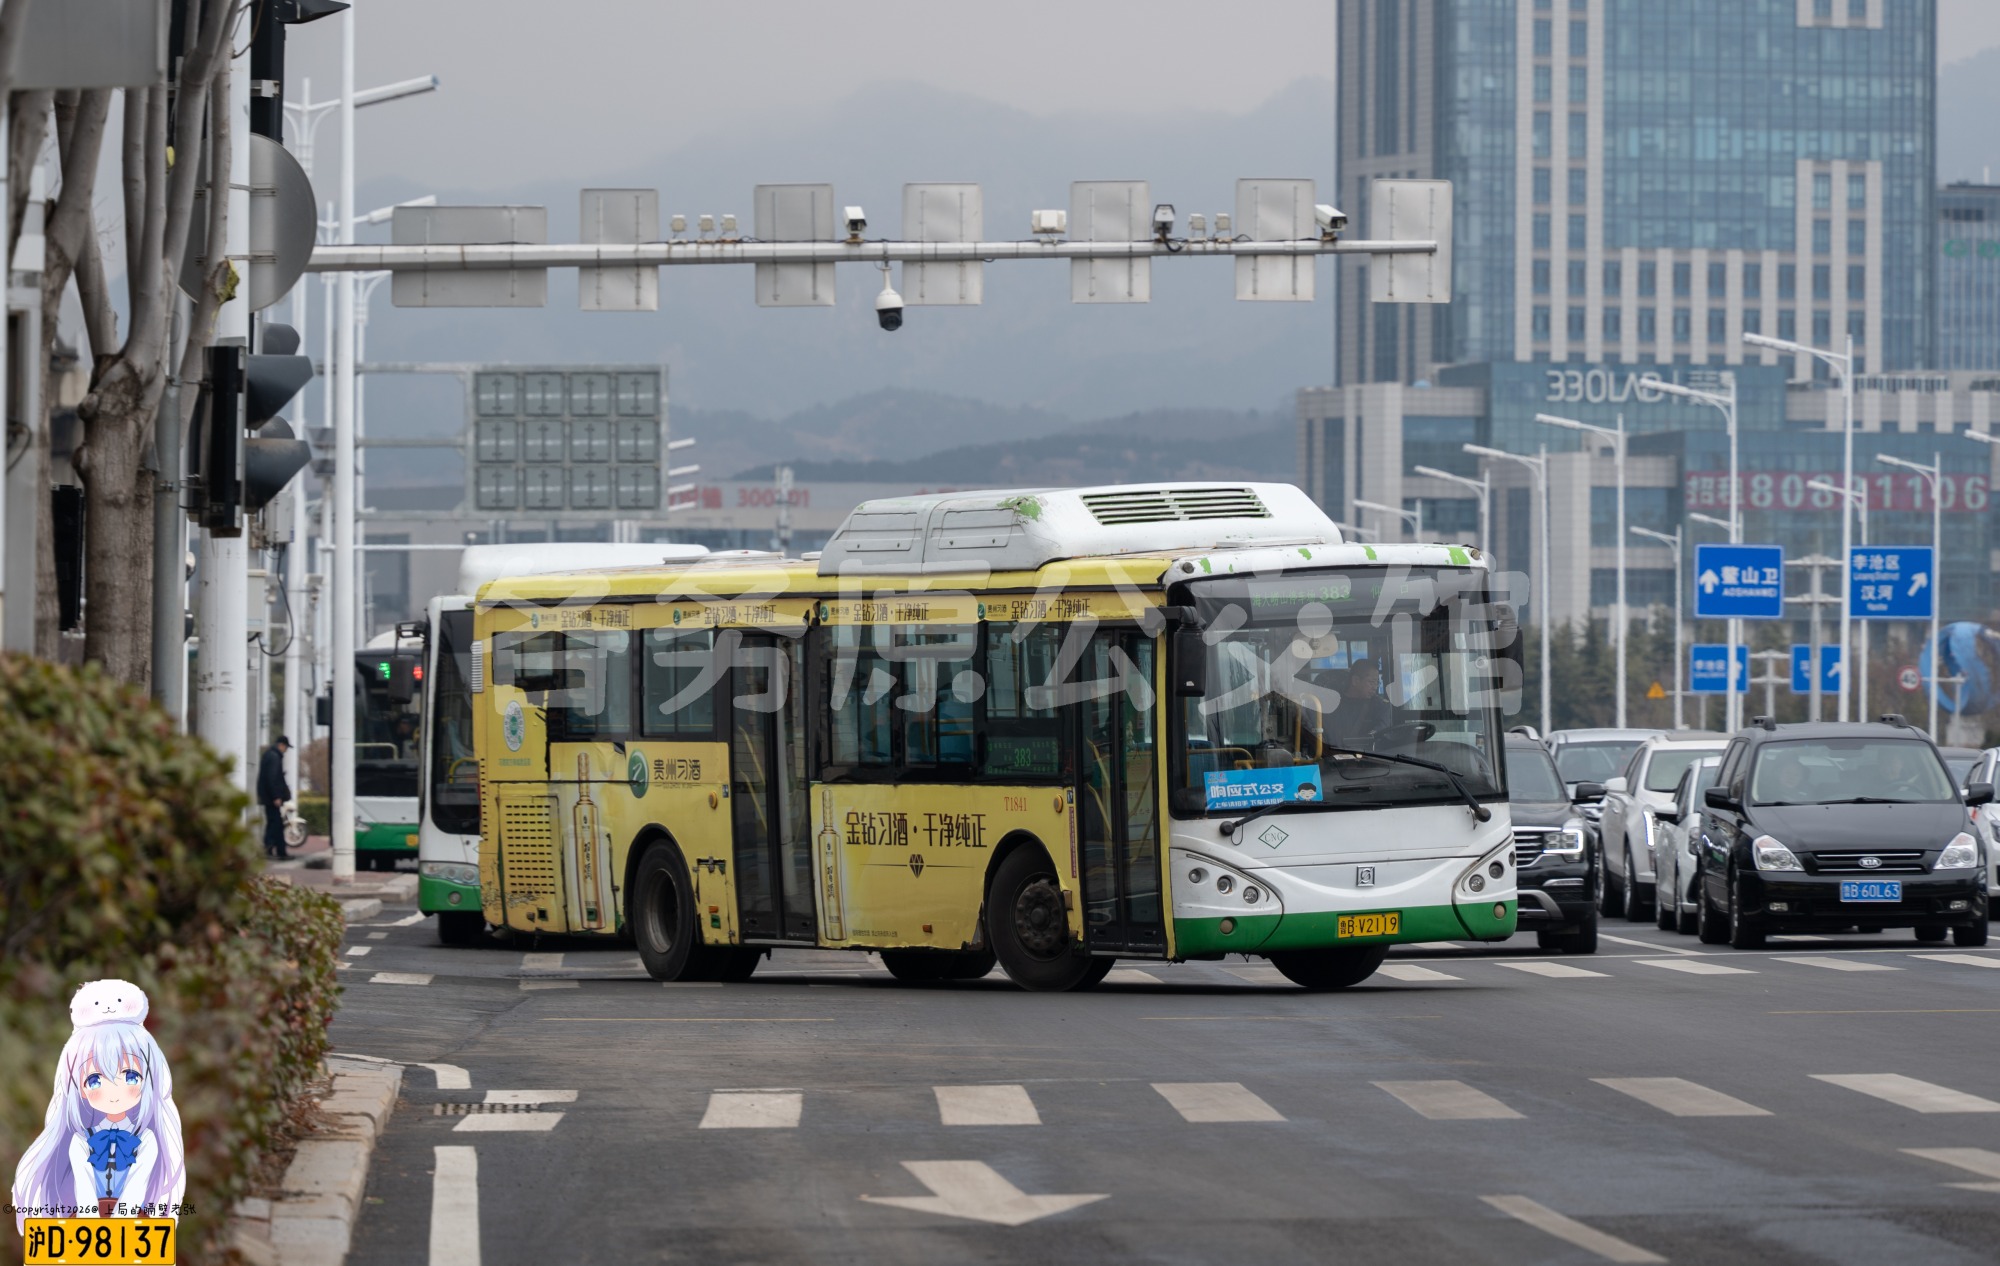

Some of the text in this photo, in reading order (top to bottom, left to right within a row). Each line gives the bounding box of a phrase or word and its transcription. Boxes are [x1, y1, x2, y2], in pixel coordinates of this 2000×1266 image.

[1852, 554, 1900, 571] 李沧区
[1319, 585, 1351, 601] 383
[853, 603, 930, 622] 金钻习酒·干净纯正
[1011, 598, 1091, 620] 金钻习酒·干净纯正
[1903, 674, 1916, 683] 40
[1014, 748, 1031, 767] 383
[653, 758, 701, 780] 贵州习酒
[1210, 783, 1284, 799] 响应式公交
[1004, 796, 1028, 812] T1841
[846, 812, 987, 848] 金钻习酒·干净纯正
[1264, 832, 1283, 843] CNG
[1340, 916, 1397, 935] 鲁B·V2119
